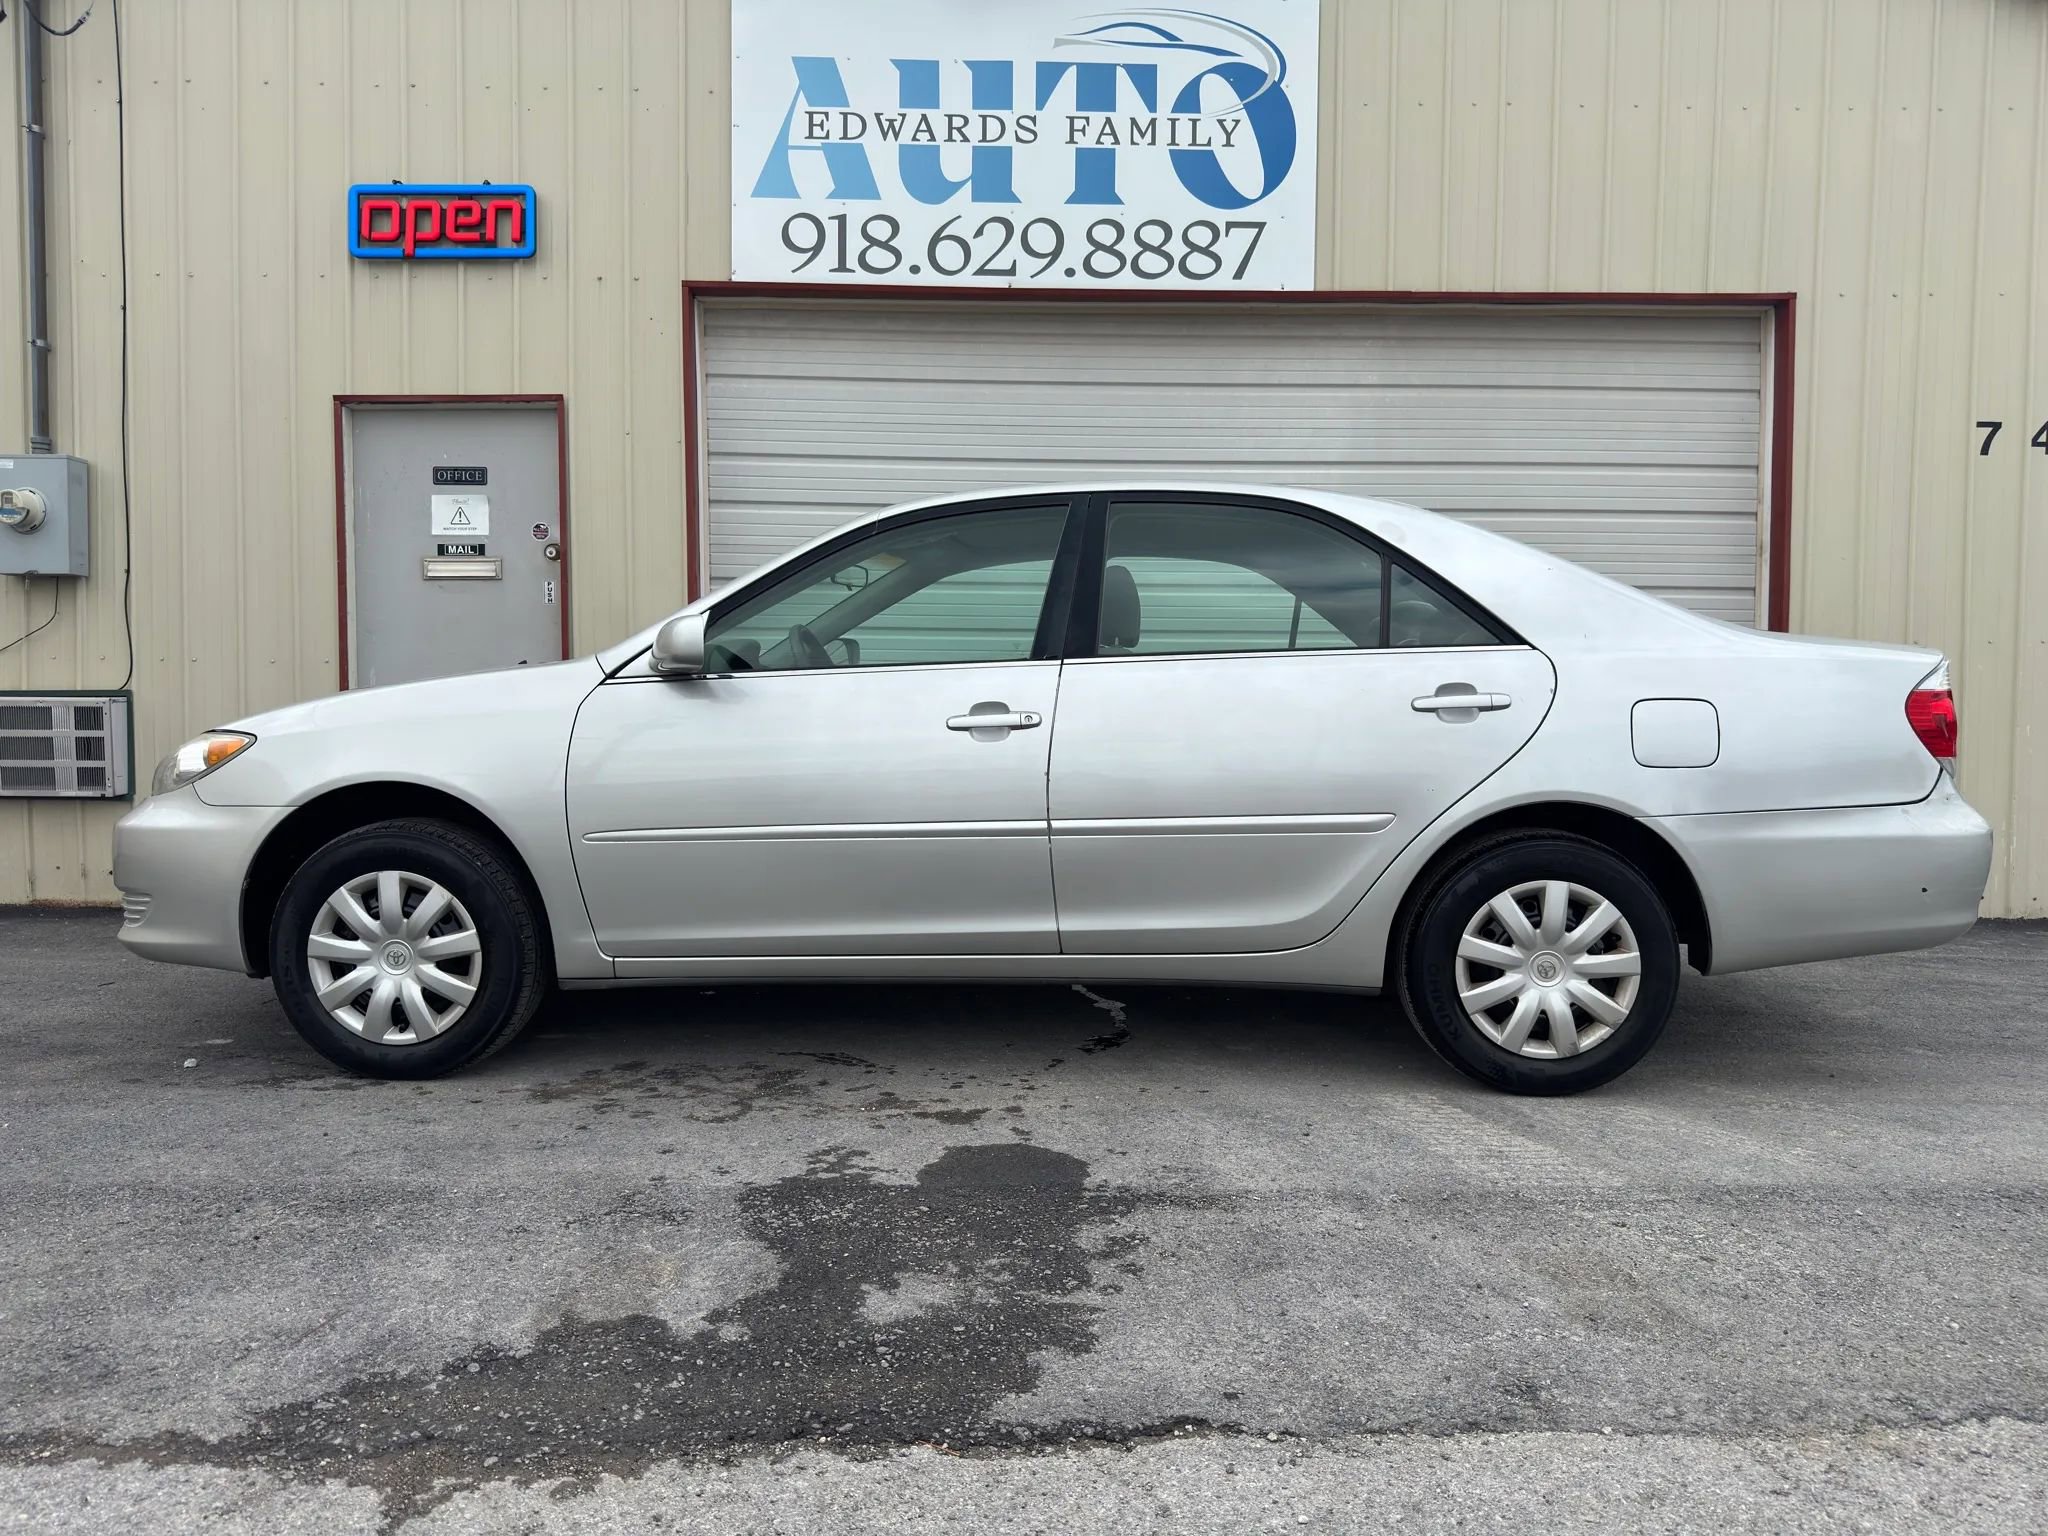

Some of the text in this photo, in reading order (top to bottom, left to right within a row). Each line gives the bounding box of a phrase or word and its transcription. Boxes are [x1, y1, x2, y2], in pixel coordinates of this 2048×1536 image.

[804, 111, 1242, 148] EDWARDS FAMILY
[361, 200, 522, 257] open
[781, 212, 1267, 281] 918.629.8887
[437, 470, 482, 481] OFFICE
[448, 545, 475, 554] MAIL
[1427, 963, 1463, 1040] KUMHO
